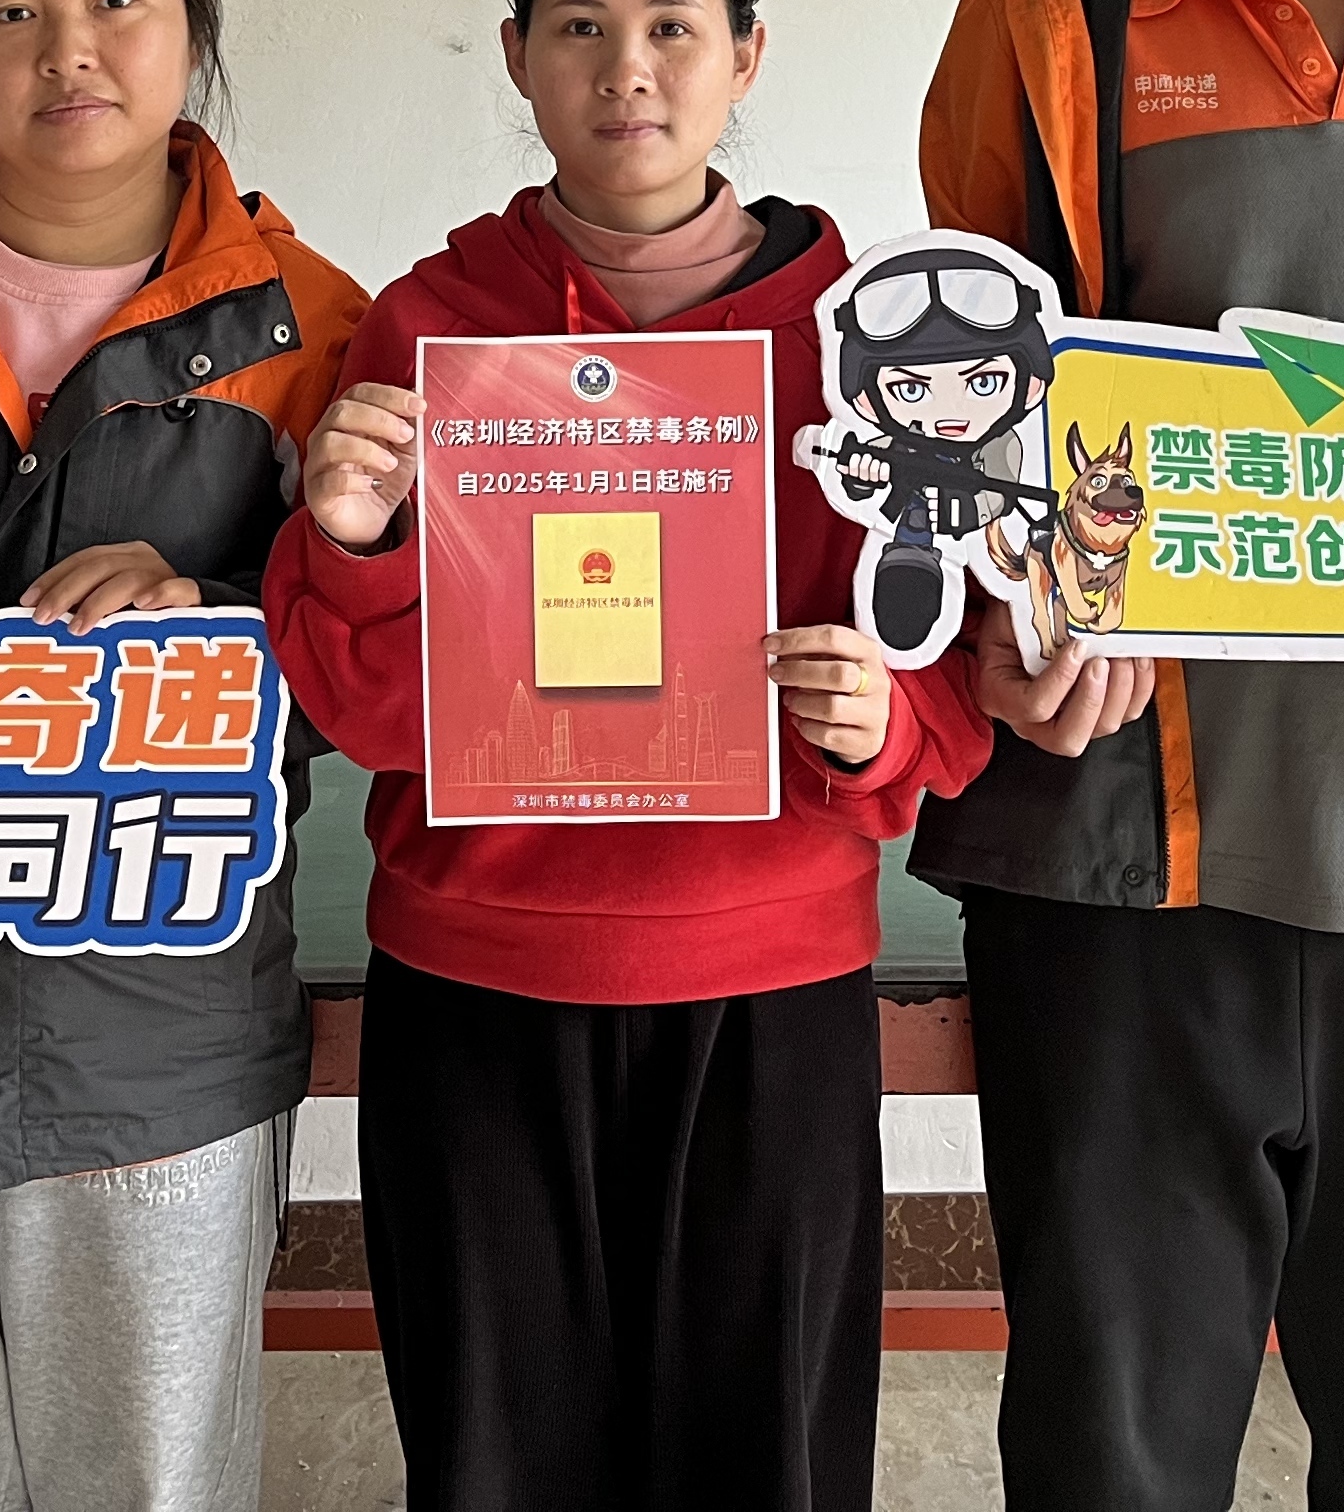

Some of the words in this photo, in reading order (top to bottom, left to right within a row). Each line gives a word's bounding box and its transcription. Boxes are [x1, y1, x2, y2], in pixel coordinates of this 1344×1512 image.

[1135, 73, 1218, 96] 申通快递
[1137, 96, 1219, 114] express
[430, 414, 759, 448] 《深圳经济特区禁毒条例》
[457, 468, 733, 496] 自2025年1月1日起施行
[542, 597, 654, 609] 深圳经济特区禁毒条例
[512, 792, 690, 809] 深圳市禁毒委员会办公室
